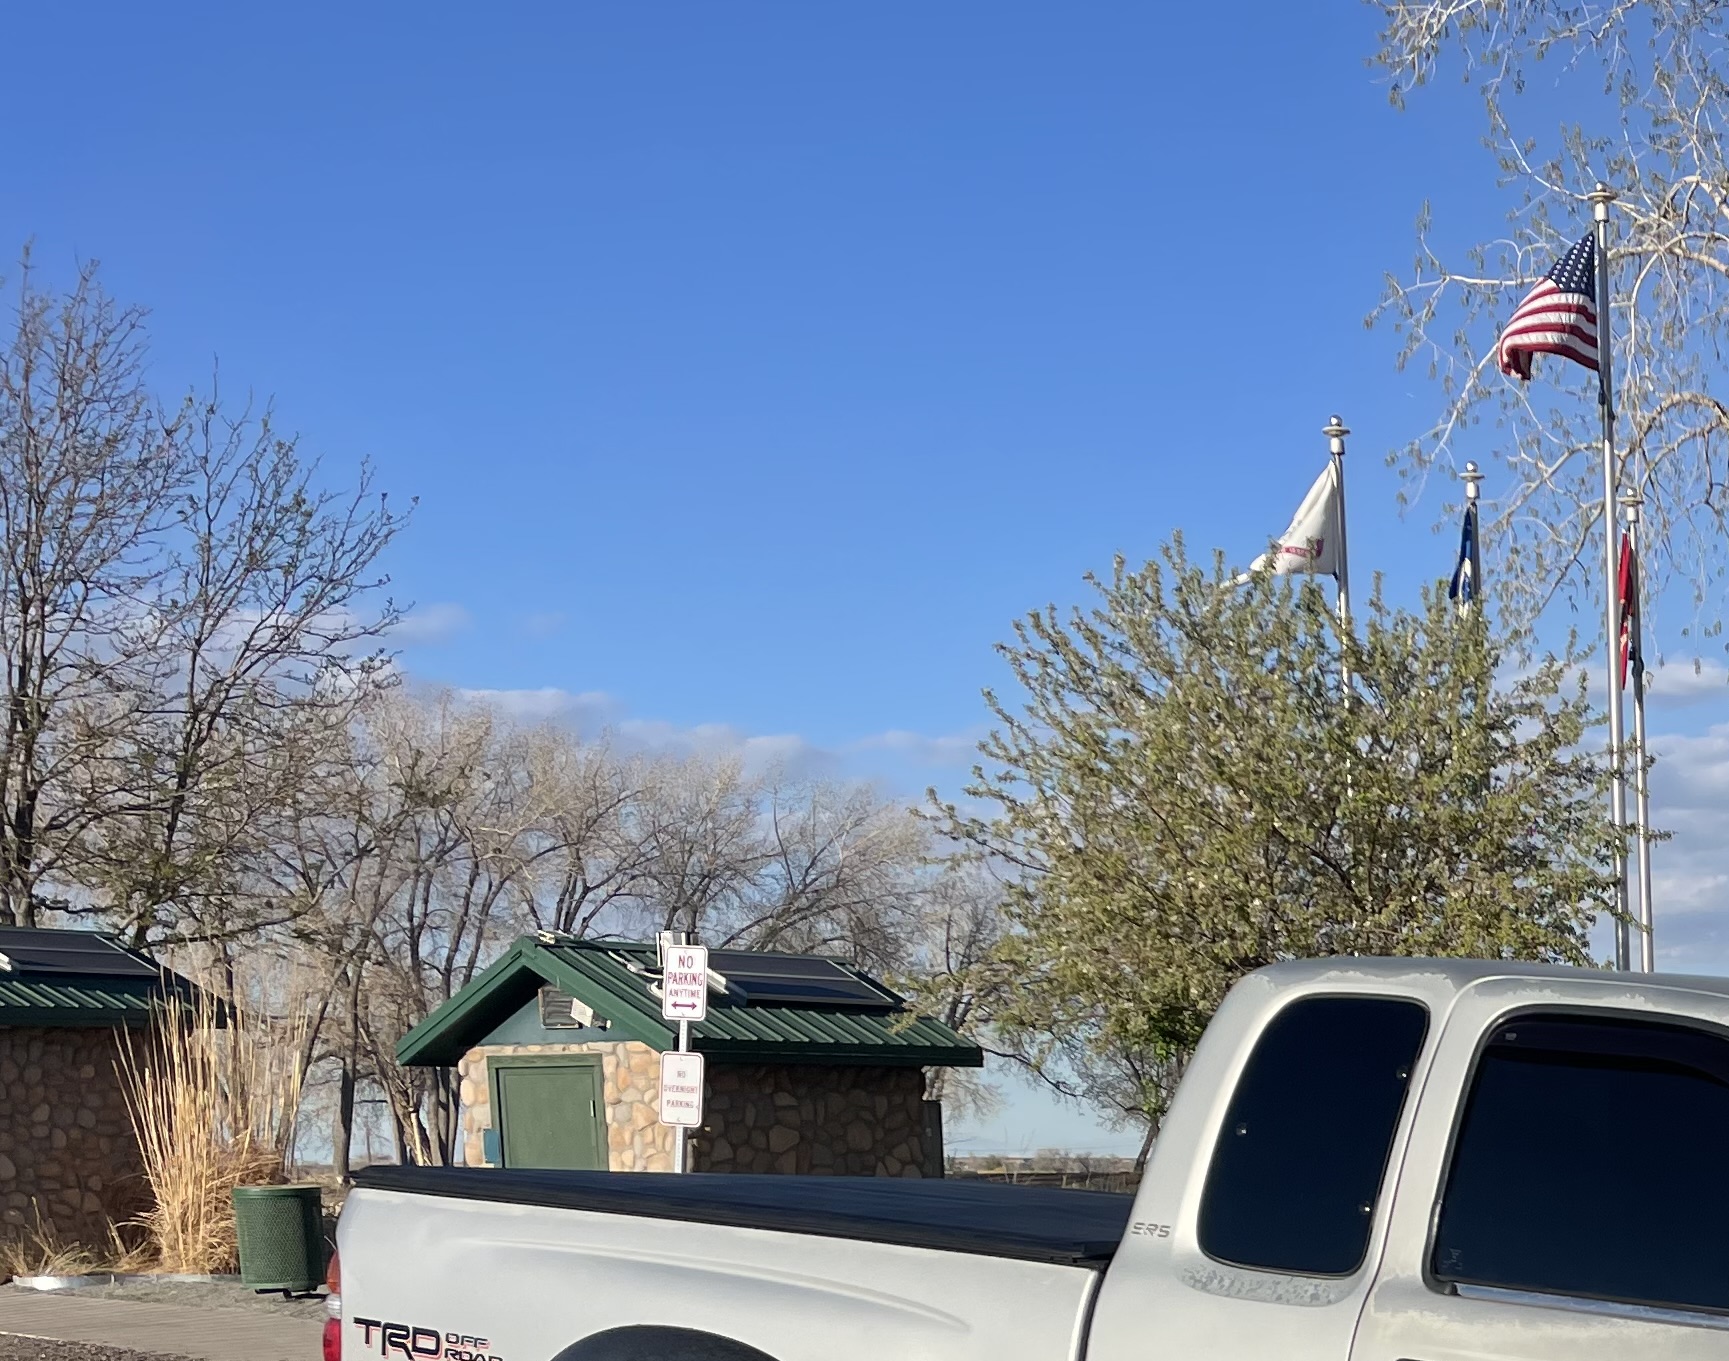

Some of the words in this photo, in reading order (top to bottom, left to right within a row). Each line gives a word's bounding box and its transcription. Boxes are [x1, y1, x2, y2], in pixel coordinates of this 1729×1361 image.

[678, 955, 694, 969] NO
[668, 972, 703, 986] PARKING
[668, 989, 701, 999] ANYTIME
[677, 1070, 686, 1078] NO
[663, 1084, 698, 1094] OVERNIGHT
[666, 1099, 694, 1108] PARKING
[445, 1332, 490, 1349] OFF
